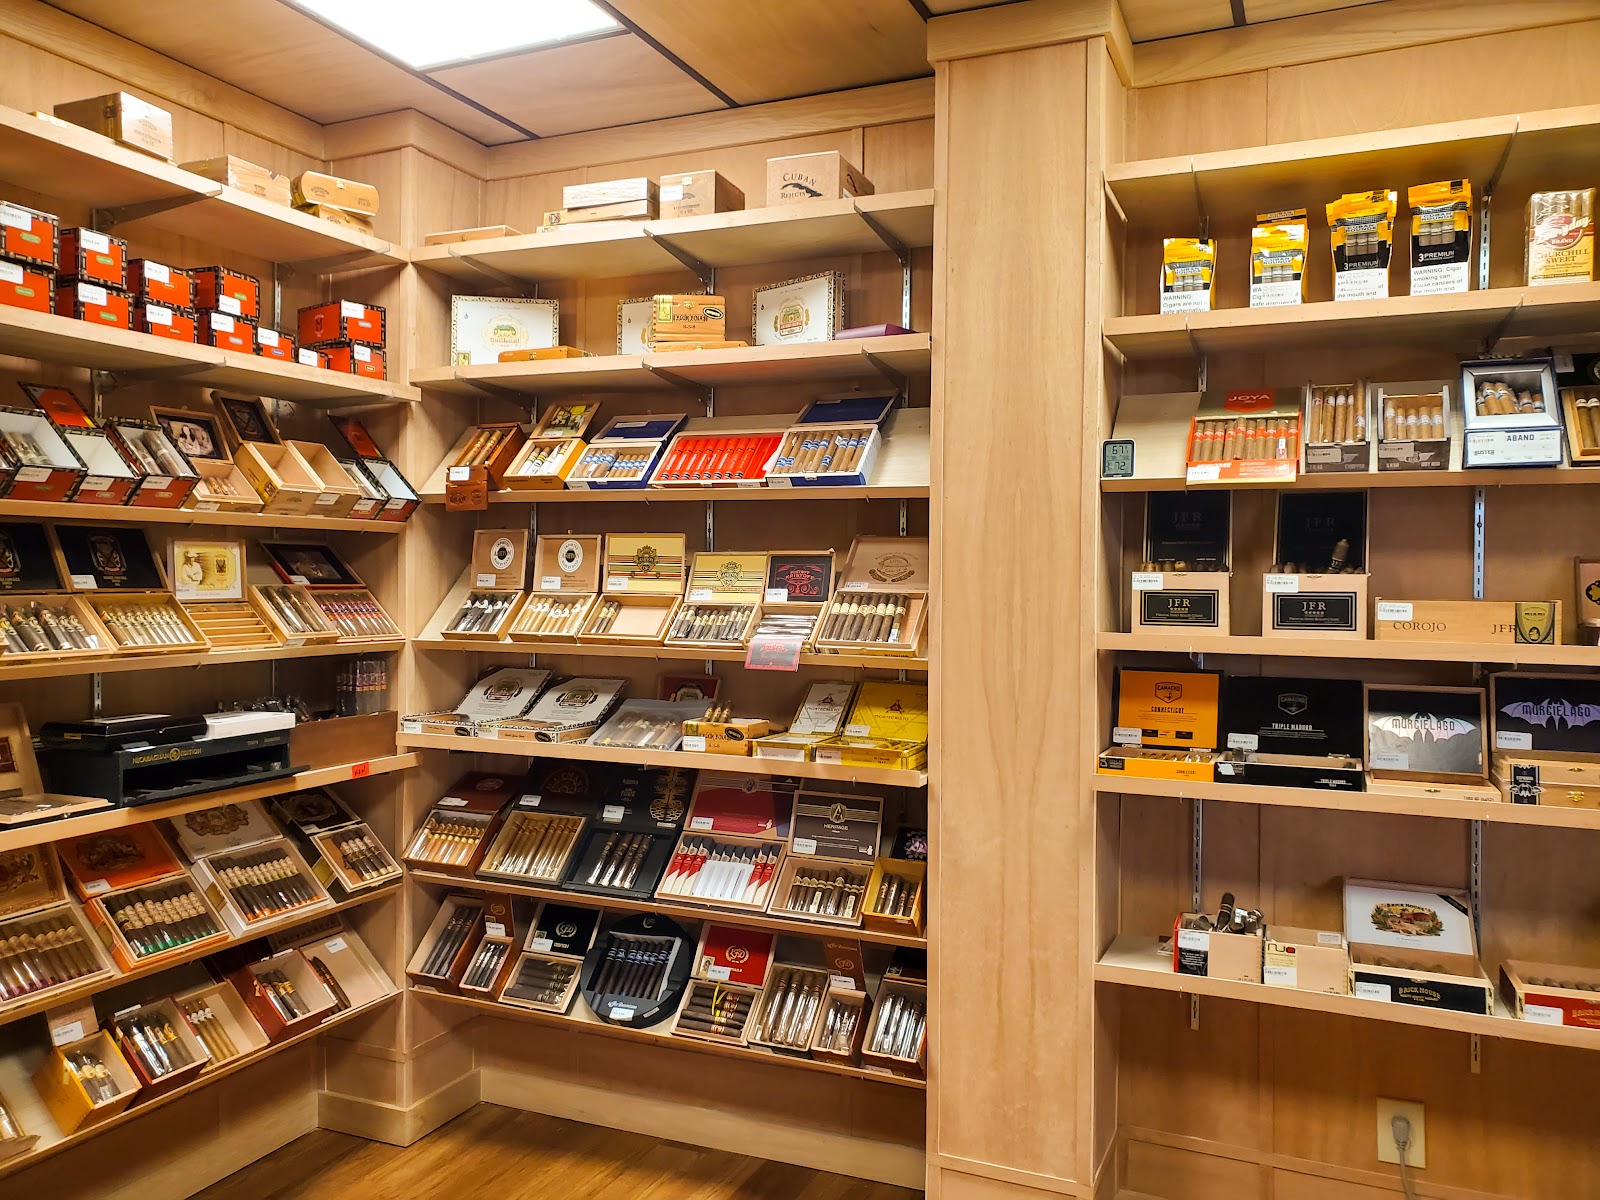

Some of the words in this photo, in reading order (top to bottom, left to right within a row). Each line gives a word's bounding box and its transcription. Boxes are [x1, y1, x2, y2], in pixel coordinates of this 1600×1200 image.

[782, 172, 817, 187] CUBAN
[780, 191, 806, 199] REJECTS
[1418, 253, 1424, 262] 3
[1545, 256, 1577, 264] SWEET
[1344, 262, 1349, 271] 3
[1413, 267, 1444, 275] WARNING:
[1446, 266, 1462, 274] Cigar
[1413, 274, 1438, 282] smoking
[1424, 286, 1443, 294] mouth
[1228, 393, 1271, 402] JOYA
[1112, 445, 1124, 455] 67
[1115, 461, 1126, 471] 72
[1168, 598, 1191, 608] JFR
[1302, 601, 1327, 612] JFR
[1393, 621, 1447, 633] COROJO
[1157, 684, 1180, 692] CAMACHO
[1151, 705, 1185, 714] CONNECTICUT
[1522, 704, 1591, 718] MURCIELAGO
[1272, 722, 1290, 730] TRIPLE
[1290, 723, 1313, 731] MADURO
[1392, 718, 1455, 731] MURCIELAGO
[132, 752, 170, 764] NICARAGUAN
[823, 823, 849, 831] HERITAGE
